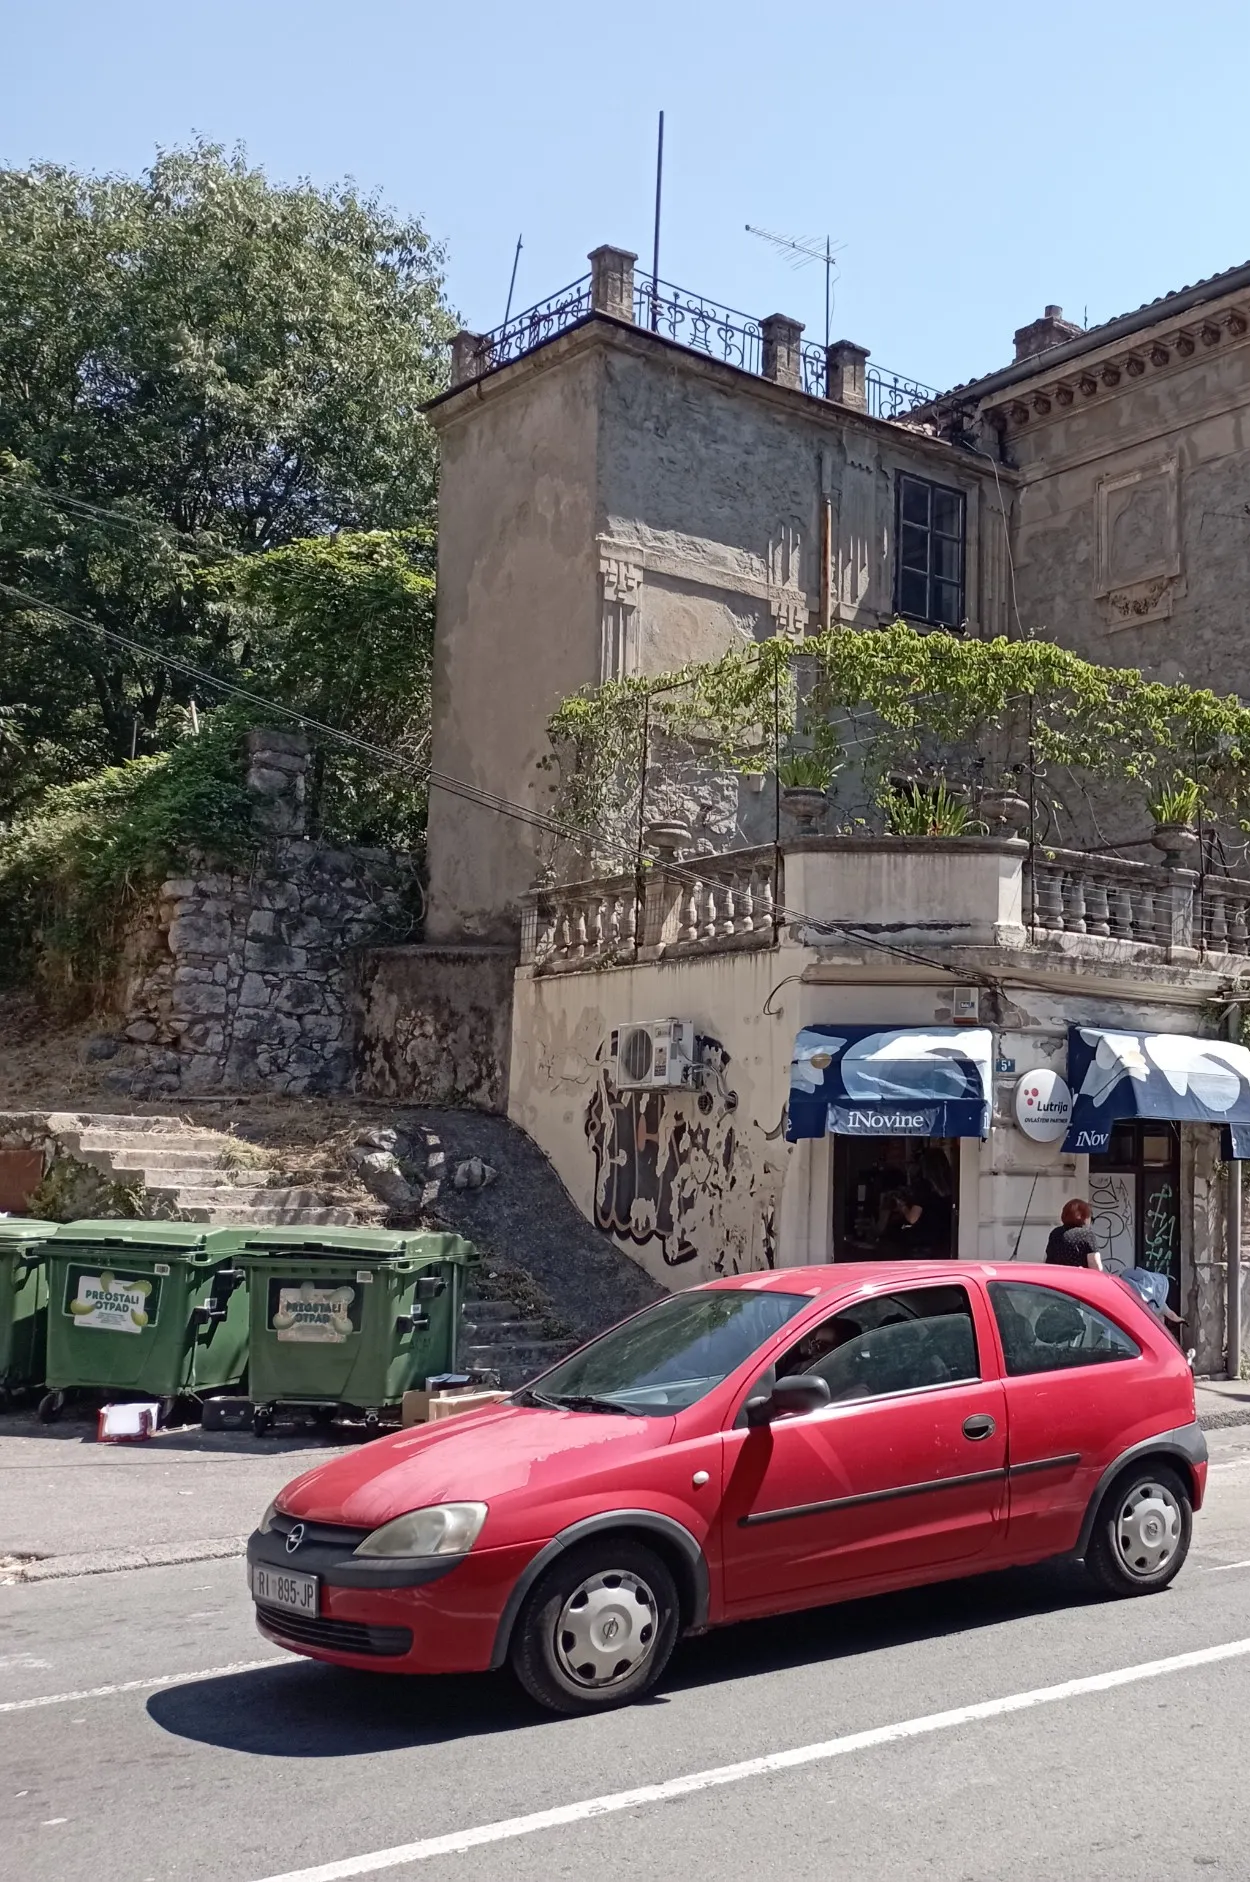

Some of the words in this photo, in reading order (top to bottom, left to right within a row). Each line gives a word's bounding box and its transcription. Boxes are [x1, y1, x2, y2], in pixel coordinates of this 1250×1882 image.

[1037, 1101, 1069, 1114] Lutrija
[848, 1111, 924, 1128] iNovine
[85, 1289, 140, 1305] PREOSTALI
[95, 1301, 130, 1313] OTPAD
[258, 1571, 269, 1597] RI
[278, 1577, 314, 1608] 895-JP
